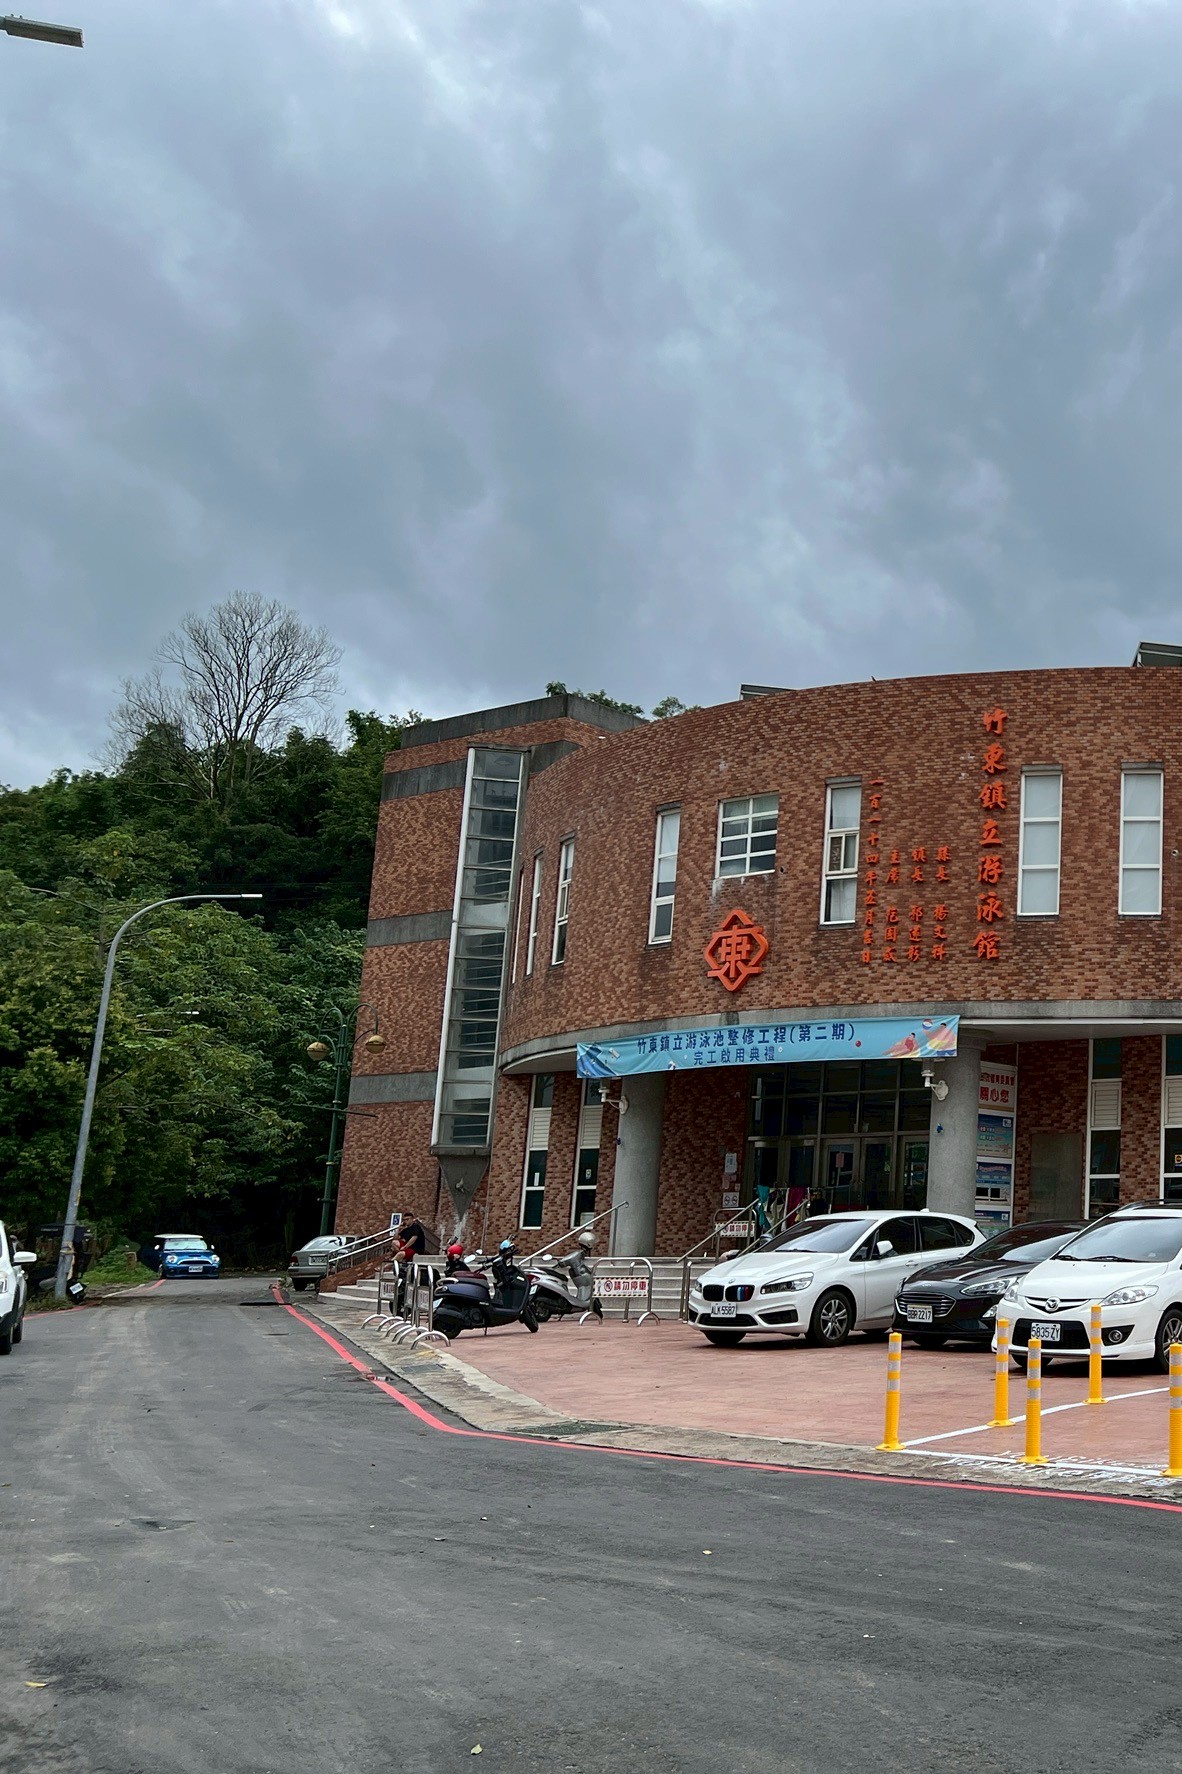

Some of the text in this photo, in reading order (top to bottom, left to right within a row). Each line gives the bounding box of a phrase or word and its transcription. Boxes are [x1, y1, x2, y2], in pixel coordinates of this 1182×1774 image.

[972, 708, 1008, 960] 竹東鎮立游泳館
[637, 1022, 856, 1055] 竹東鎮立游泳池整修工程(第二期)
